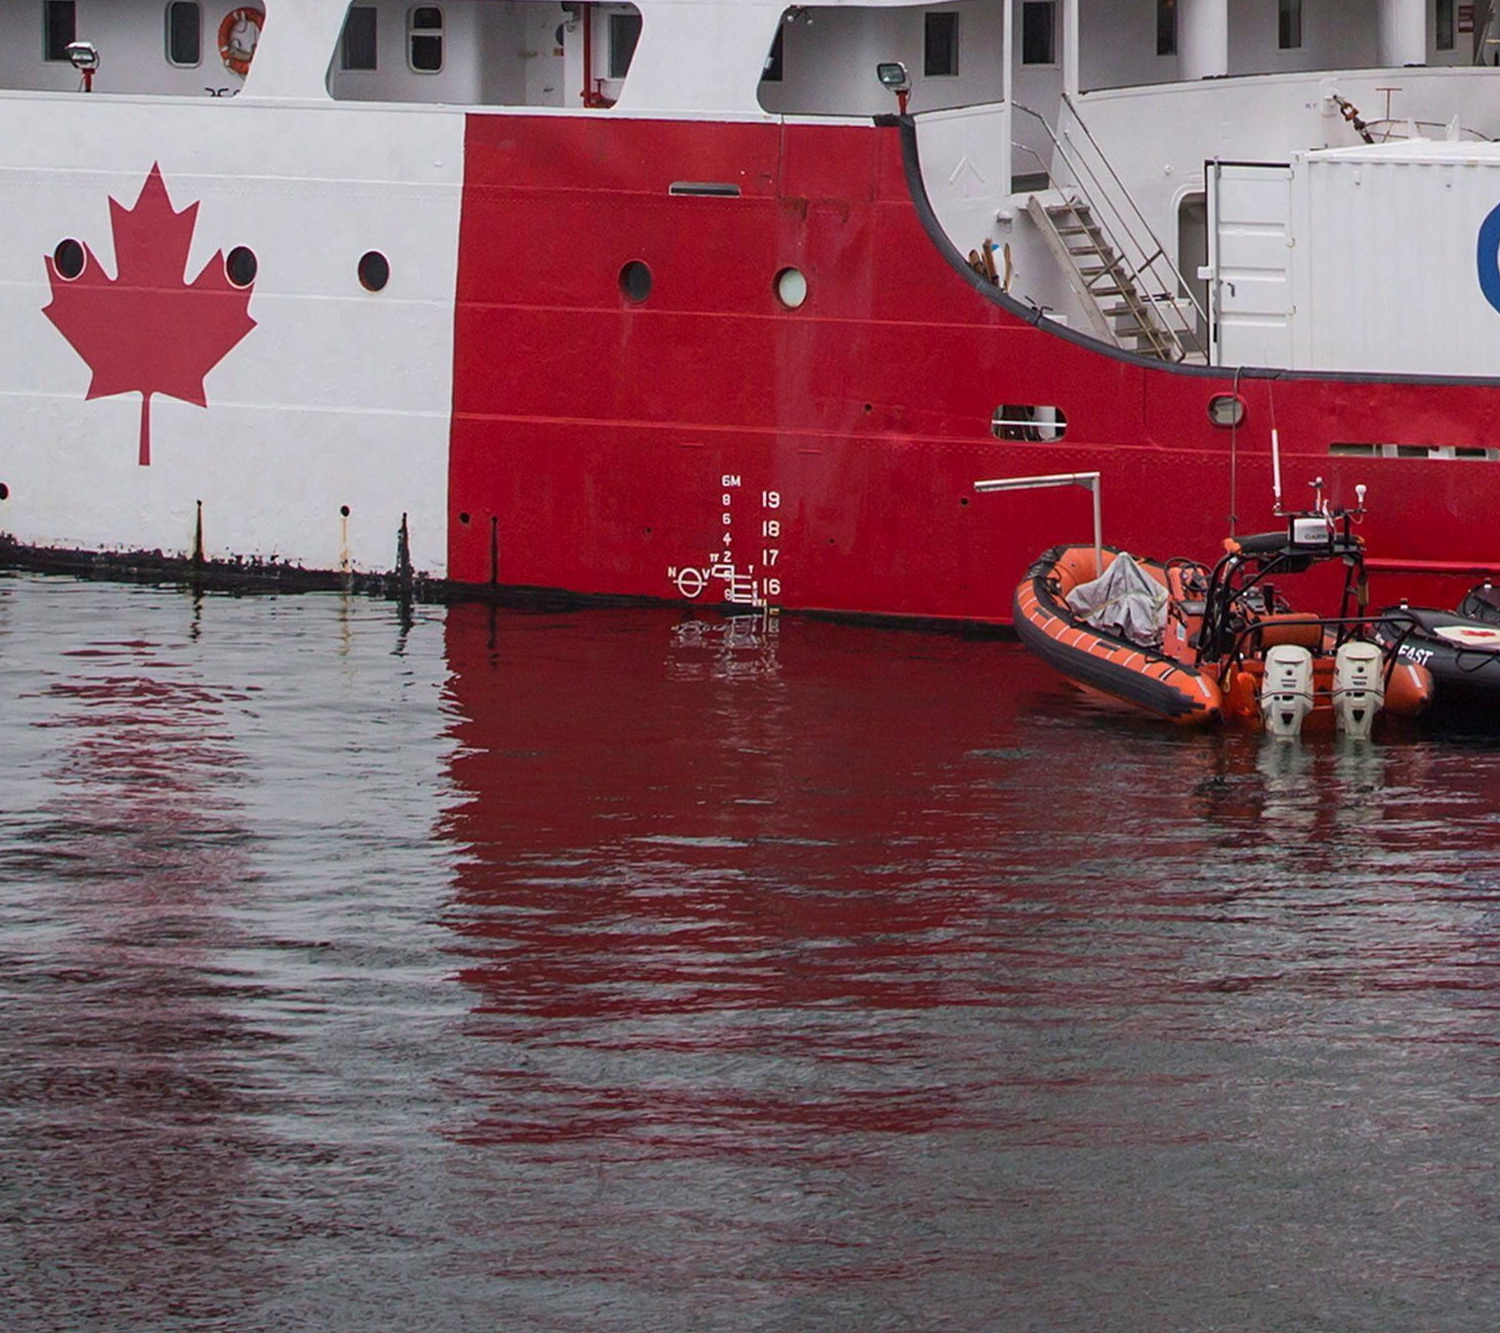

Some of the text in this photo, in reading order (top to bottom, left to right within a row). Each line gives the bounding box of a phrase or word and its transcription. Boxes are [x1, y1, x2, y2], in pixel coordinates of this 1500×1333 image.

[722, 475, 741, 487] 6M
[722, 493, 731, 506] 8
[762, 491, 780, 508] 19
[722, 513, 731, 525] 6
[762, 520, 780, 537] 18
[762, 549, 779, 566] 17
[763, 578, 781, 595] 16
[1398, 644, 1434, 666] EAST
